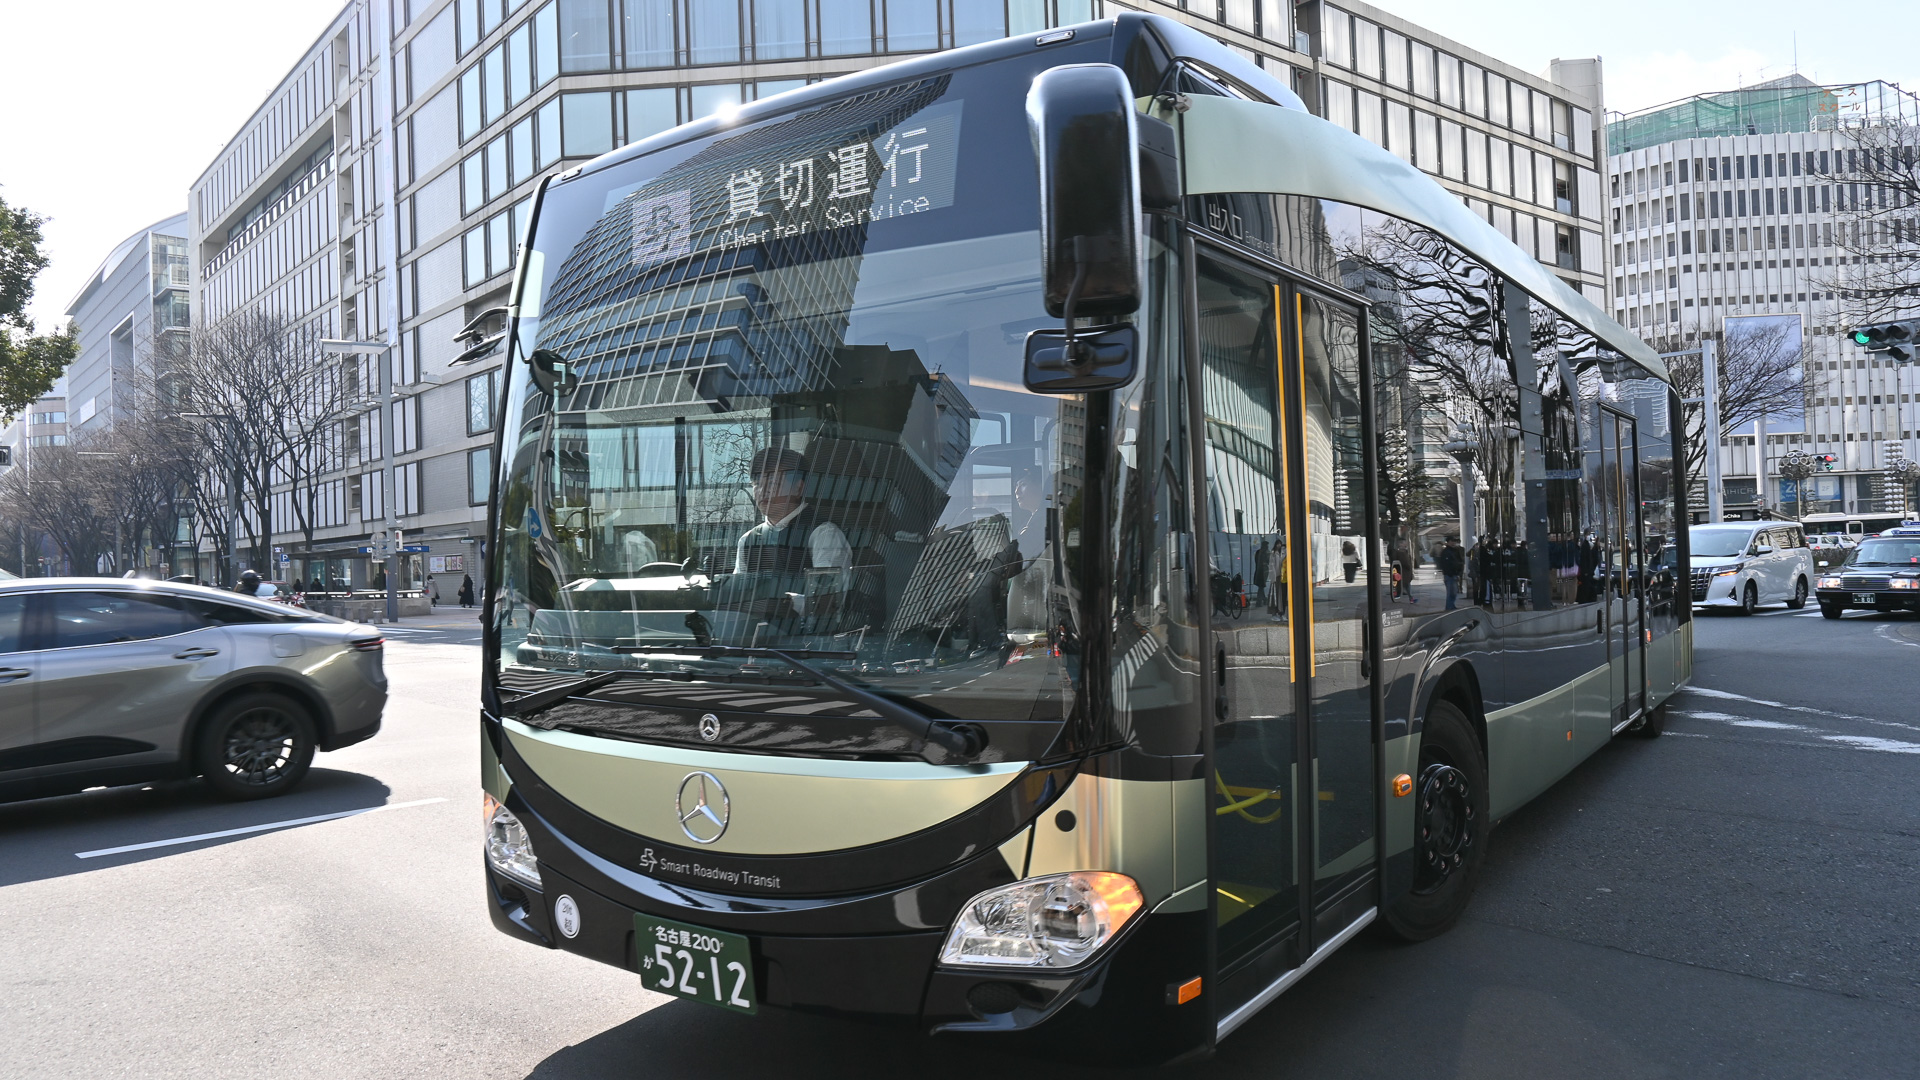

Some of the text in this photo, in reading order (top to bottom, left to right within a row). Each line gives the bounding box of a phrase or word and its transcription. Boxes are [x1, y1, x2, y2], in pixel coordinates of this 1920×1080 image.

[1818, 102, 1861, 112] スクール
[724, 127, 930, 224] 貸切運行
[720, 194, 930, 250] Charter Service
[1208, 203, 1243, 240] 出入口
[660, 858, 781, 889] Smart Roadway Transit
[643, 943, 751, 1009] か 52-12
